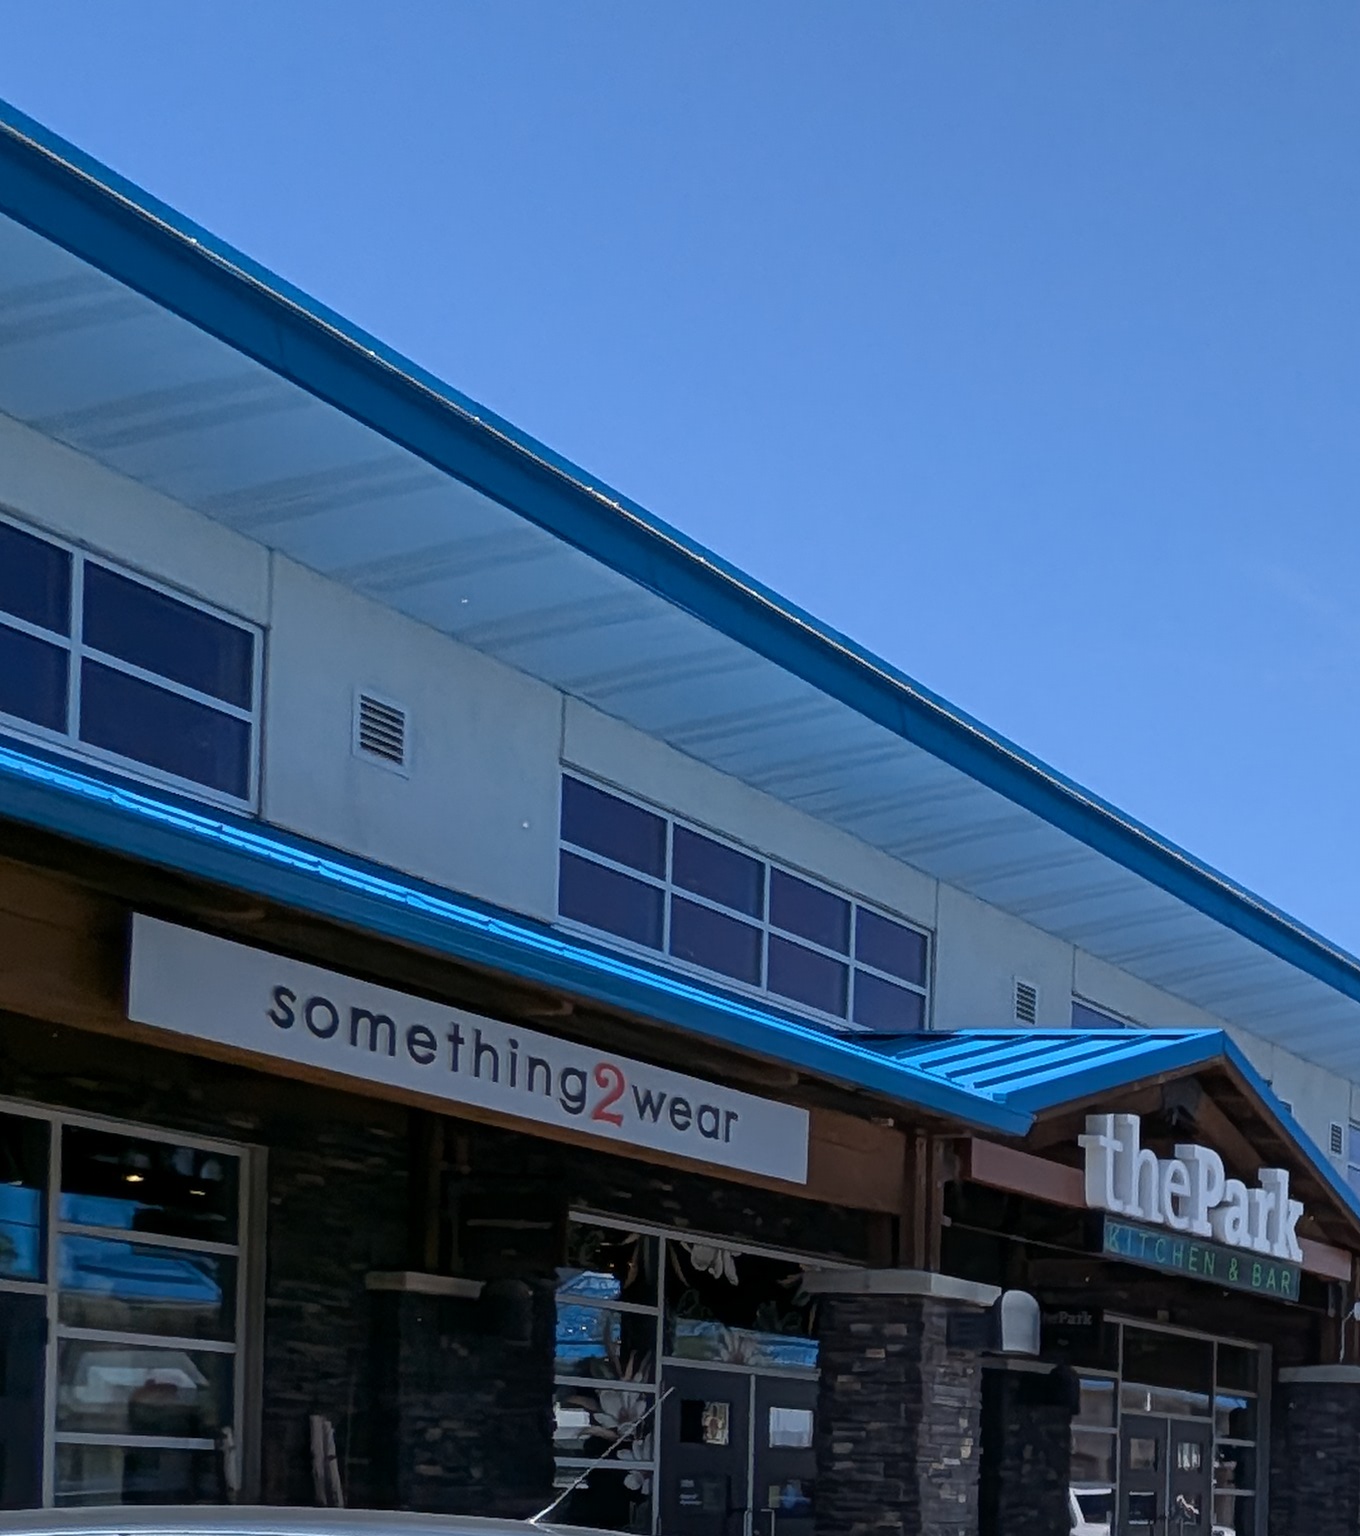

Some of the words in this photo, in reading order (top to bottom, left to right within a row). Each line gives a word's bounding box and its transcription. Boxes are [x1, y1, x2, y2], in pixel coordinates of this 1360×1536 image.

[266, 985, 739, 1143] something2wear
[1078, 1113, 1304, 1263] thePark
[1107, 1225, 1215, 1277] KITCHEN
[1229, 1257, 1240, 1282] &
[1251, 1263, 1292, 1295] BAR
